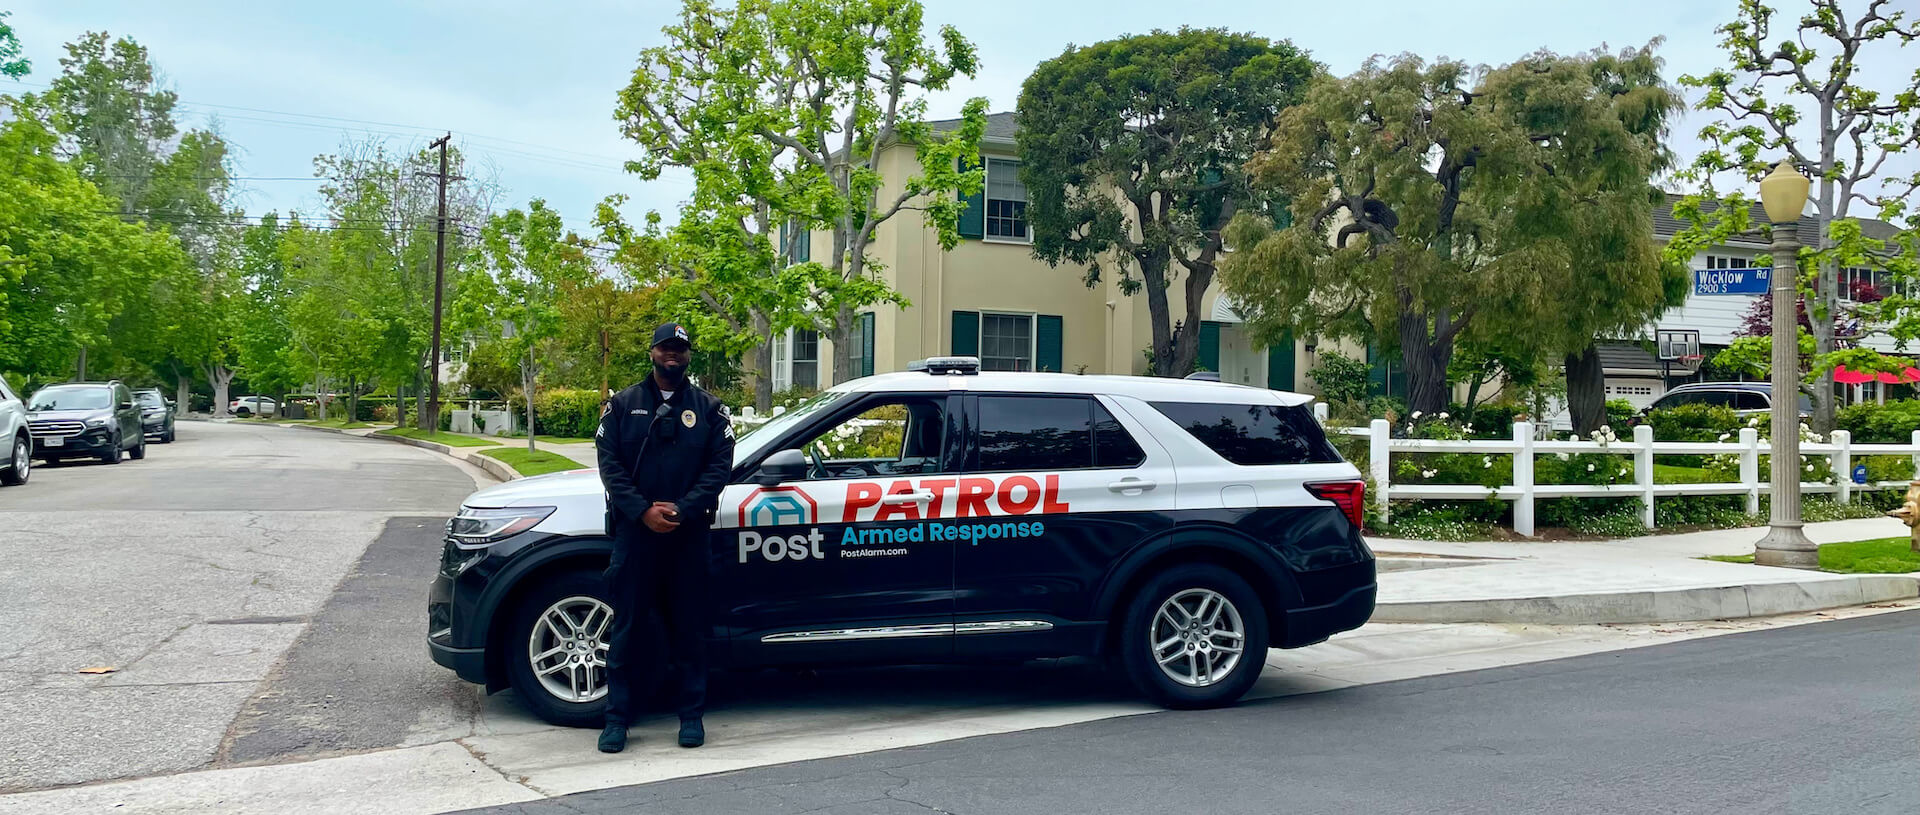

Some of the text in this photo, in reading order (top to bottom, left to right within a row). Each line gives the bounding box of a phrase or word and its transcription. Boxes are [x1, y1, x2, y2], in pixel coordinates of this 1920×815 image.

[1699, 270, 1768, 284] Wicklow Rd
[1697, 284, 1728, 294] 2900 S
[842, 474, 1070, 522] PATROL
[840, 521, 1045, 546] Armed Response
[738, 527, 825, 563] Post
[840, 548, 908, 558] PostAlarm.com
